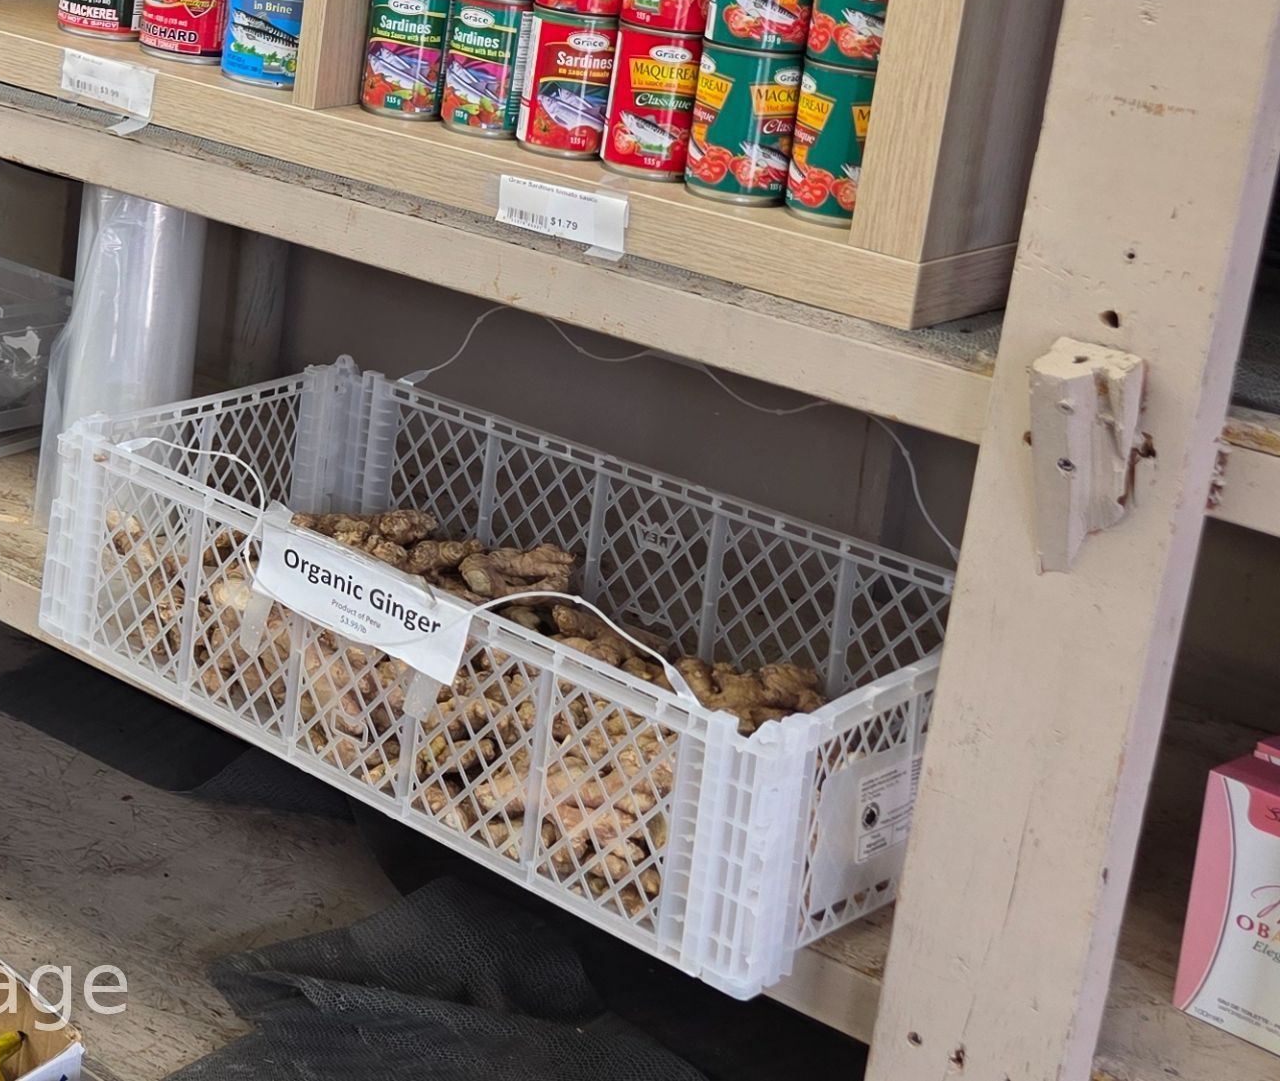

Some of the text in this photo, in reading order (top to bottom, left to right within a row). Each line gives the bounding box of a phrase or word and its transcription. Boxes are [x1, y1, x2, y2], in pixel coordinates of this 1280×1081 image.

[70, 1, 118, 21] MACKEREL
[254, 0, 293, 14] in Brine
[392, 1, 421, 11] Grace
[380, 14, 432, 34] Sardines
[463, 12, 489, 25] Grace
[453, 27, 500, 48] Sardines
[573, 37, 605, 48] Grace
[557, 51, 613, 70] Sardines
[654, 49, 687, 60] Grace
[635, 92, 691, 111] Classique
[508, 176, 598, 204] Grace Sardines tomato sauce
[550, 216, 578, 231] $1.79
[284, 548, 441, 633] Organic Ginger
[331, 598, 357, 618] Product
[365, 614, 381, 629] Peru
